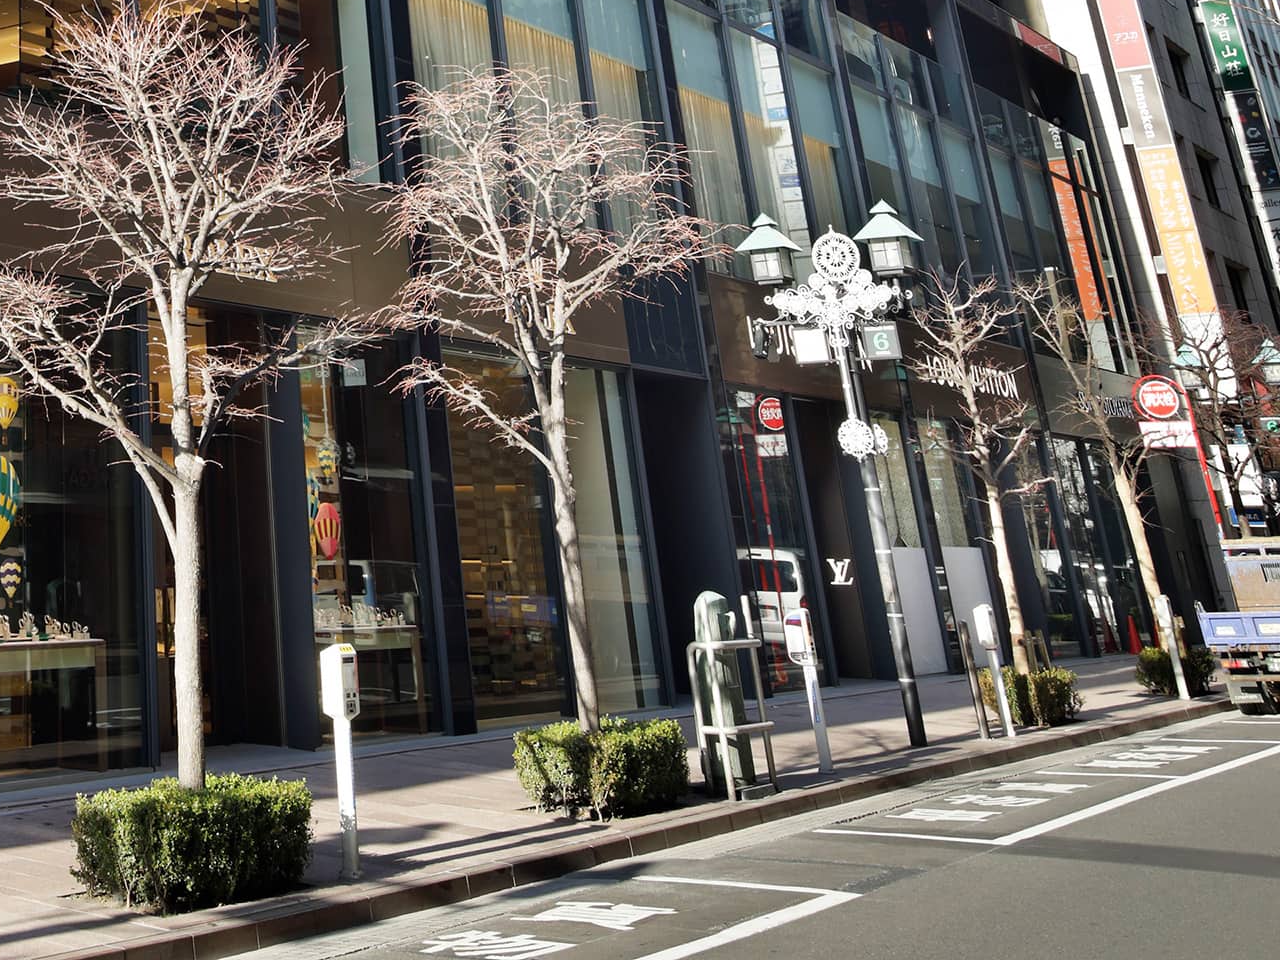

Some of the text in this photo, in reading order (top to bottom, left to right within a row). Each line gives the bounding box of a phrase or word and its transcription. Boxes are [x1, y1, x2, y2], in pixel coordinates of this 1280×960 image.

[1211, 12, 1245, 77] 好日山荘
[1129, 74, 1156, 139] Manneken
[872, 331, 890, 351] 6
[825, 557, 854, 586] LV
